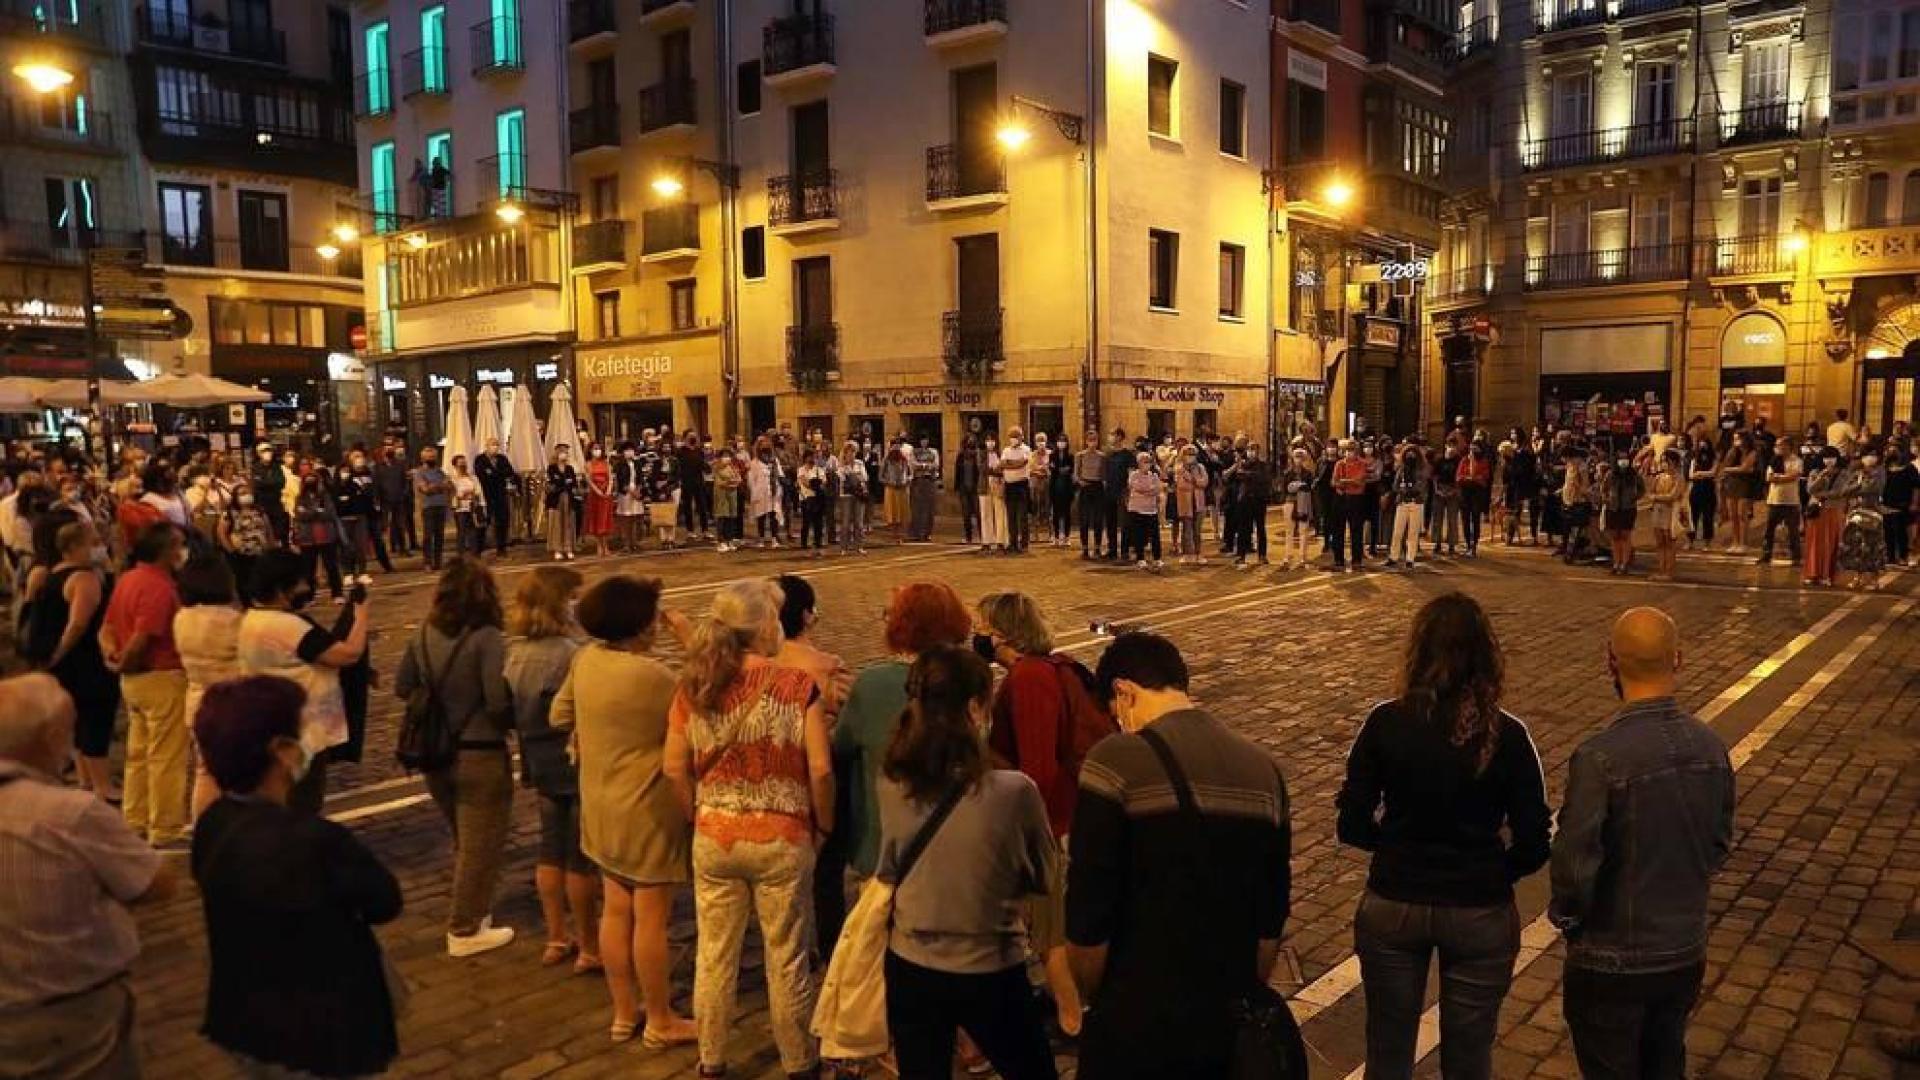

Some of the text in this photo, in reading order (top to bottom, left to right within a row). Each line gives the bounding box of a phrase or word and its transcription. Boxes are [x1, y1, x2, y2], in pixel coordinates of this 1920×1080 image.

[583, 351, 672, 379] Kafetegia
[863, 388, 981, 408] The Cookie Shop
[1132, 384, 1225, 408] The Cookie Shop
